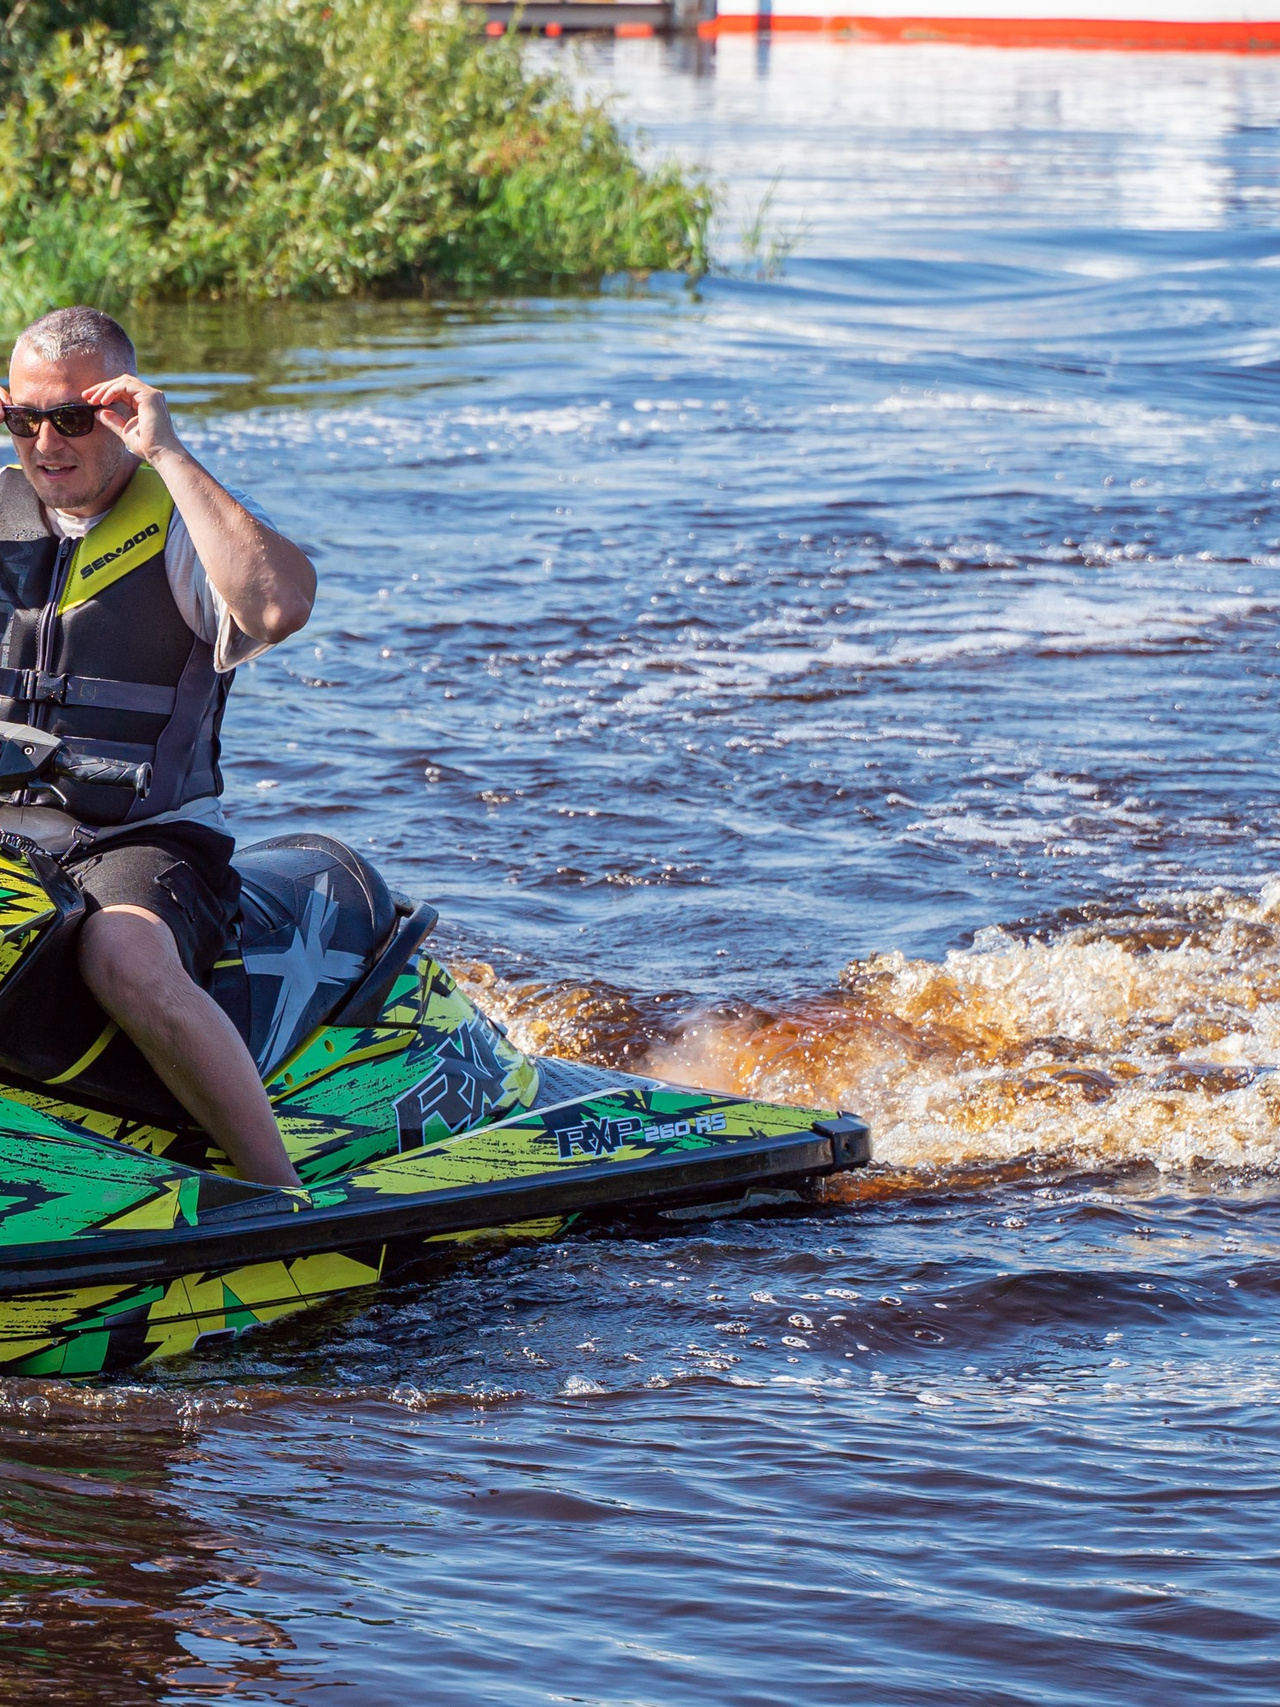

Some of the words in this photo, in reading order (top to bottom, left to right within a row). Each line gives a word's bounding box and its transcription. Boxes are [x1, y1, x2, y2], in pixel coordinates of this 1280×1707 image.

[554, 1115, 644, 1161] RXP
[643, 1120, 691, 1142] 260
[694, 1112, 728, 1134] RS
